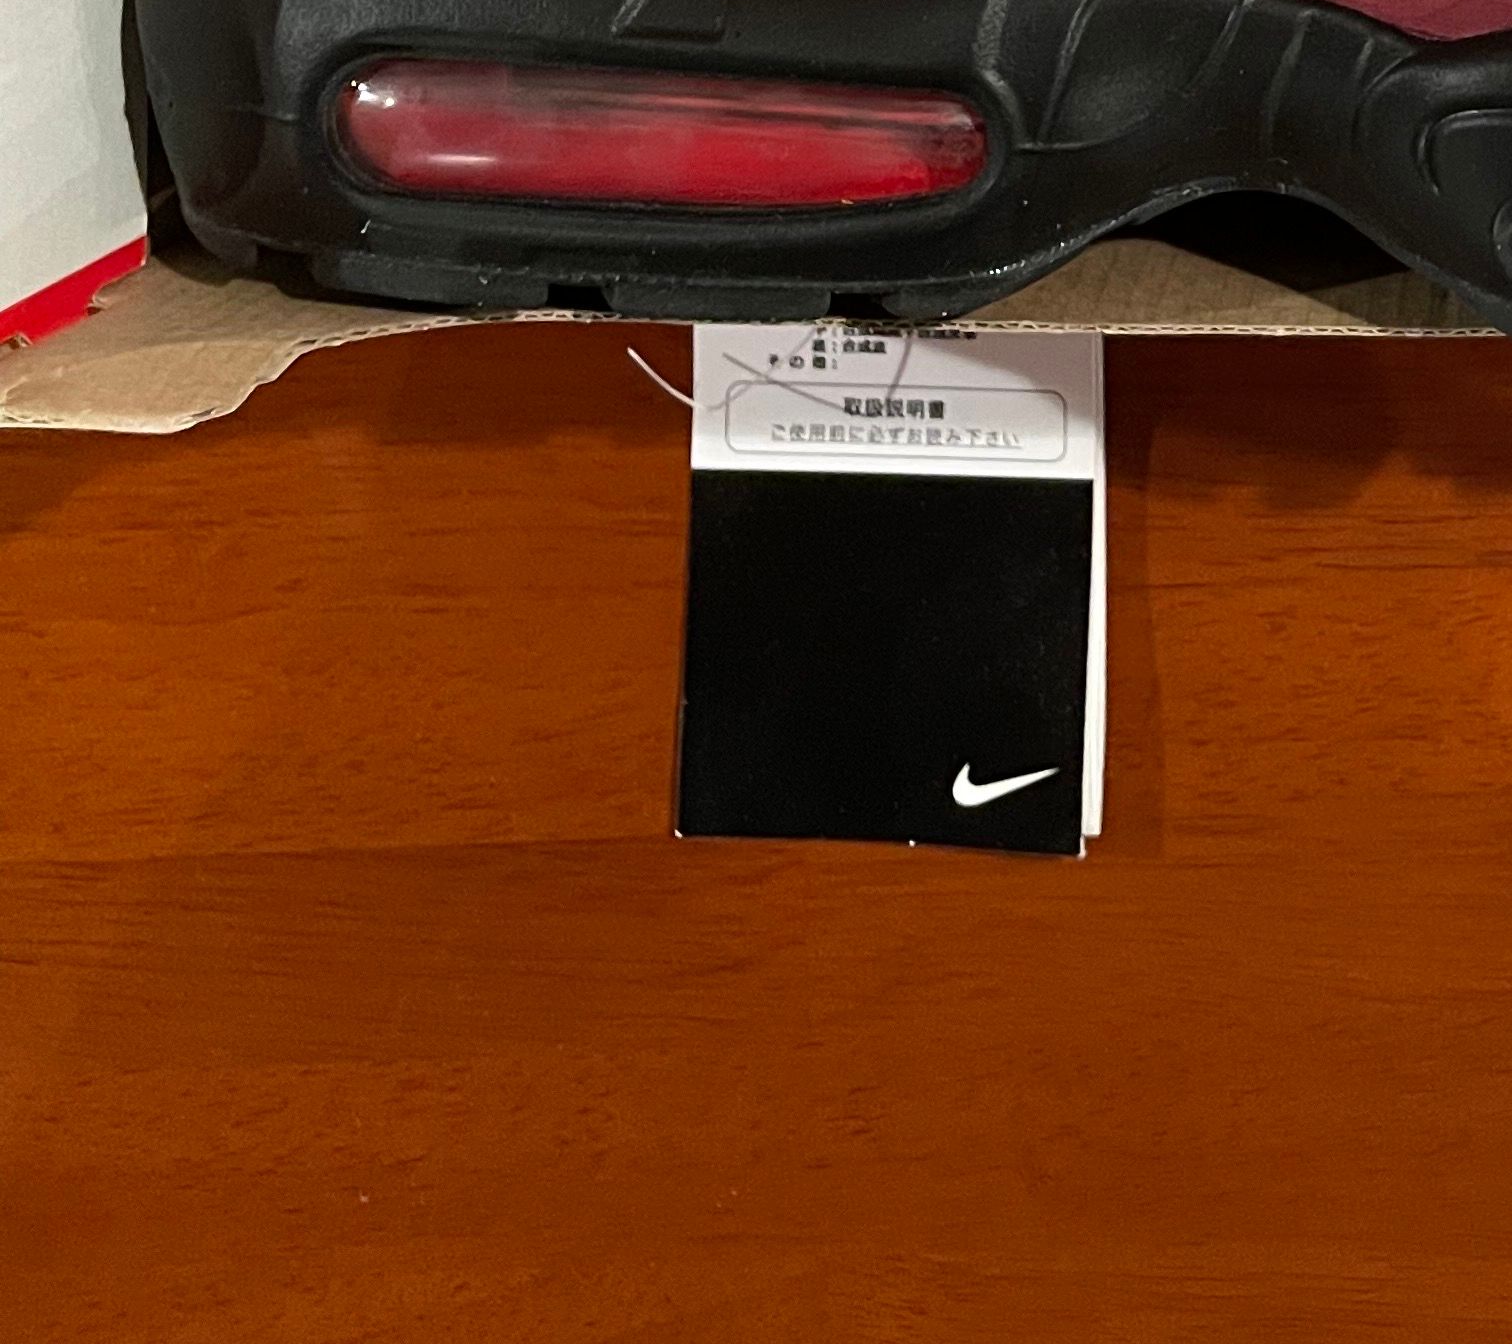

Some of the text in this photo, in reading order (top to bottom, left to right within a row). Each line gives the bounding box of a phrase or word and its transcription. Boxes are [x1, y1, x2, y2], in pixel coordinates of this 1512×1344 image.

[844, 396, 944, 420] 取扱説明書
[770, 422, 1022, 448] ご使用前に必ずお読み下さい
